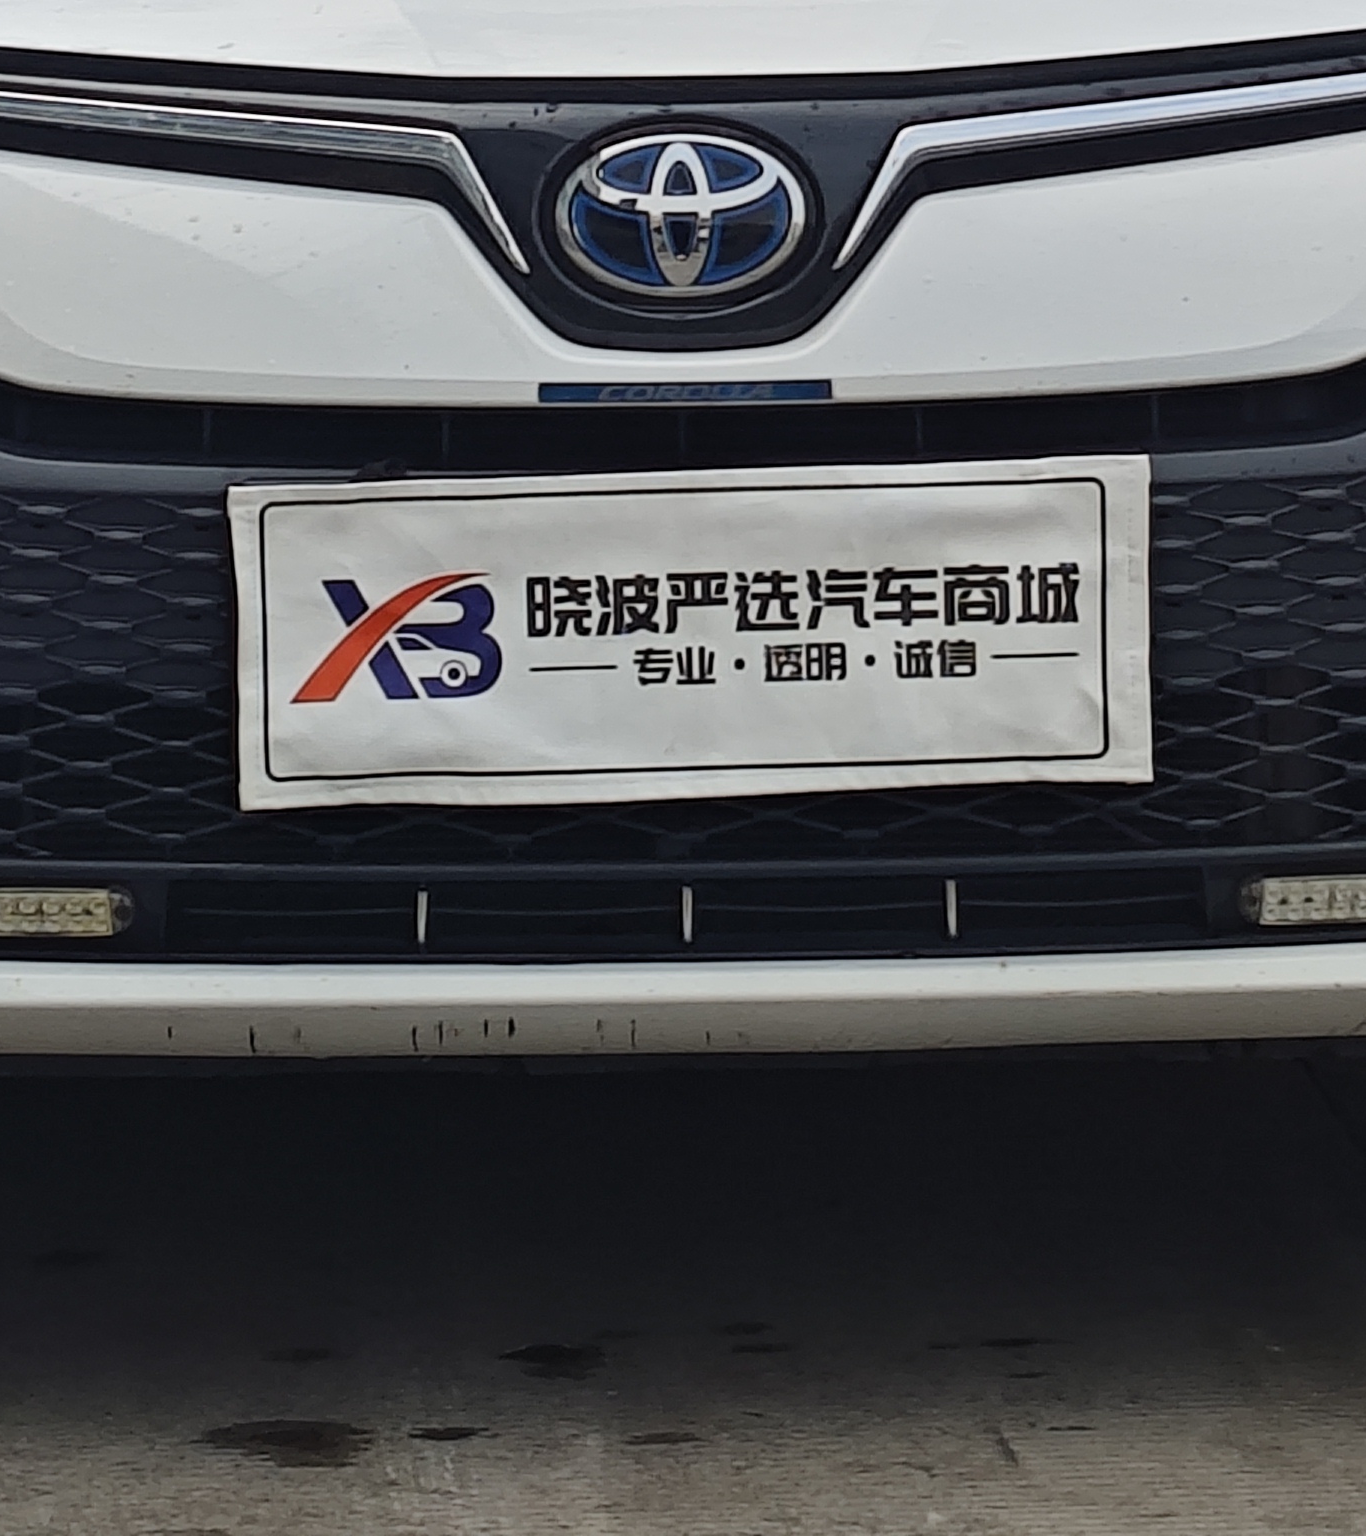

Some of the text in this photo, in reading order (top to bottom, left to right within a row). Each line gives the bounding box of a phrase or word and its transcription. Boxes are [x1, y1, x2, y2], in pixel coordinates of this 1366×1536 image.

[598, 383, 774, 402] COROLLA
[524, 562, 1081, 638] 晓波严选汽车商城
